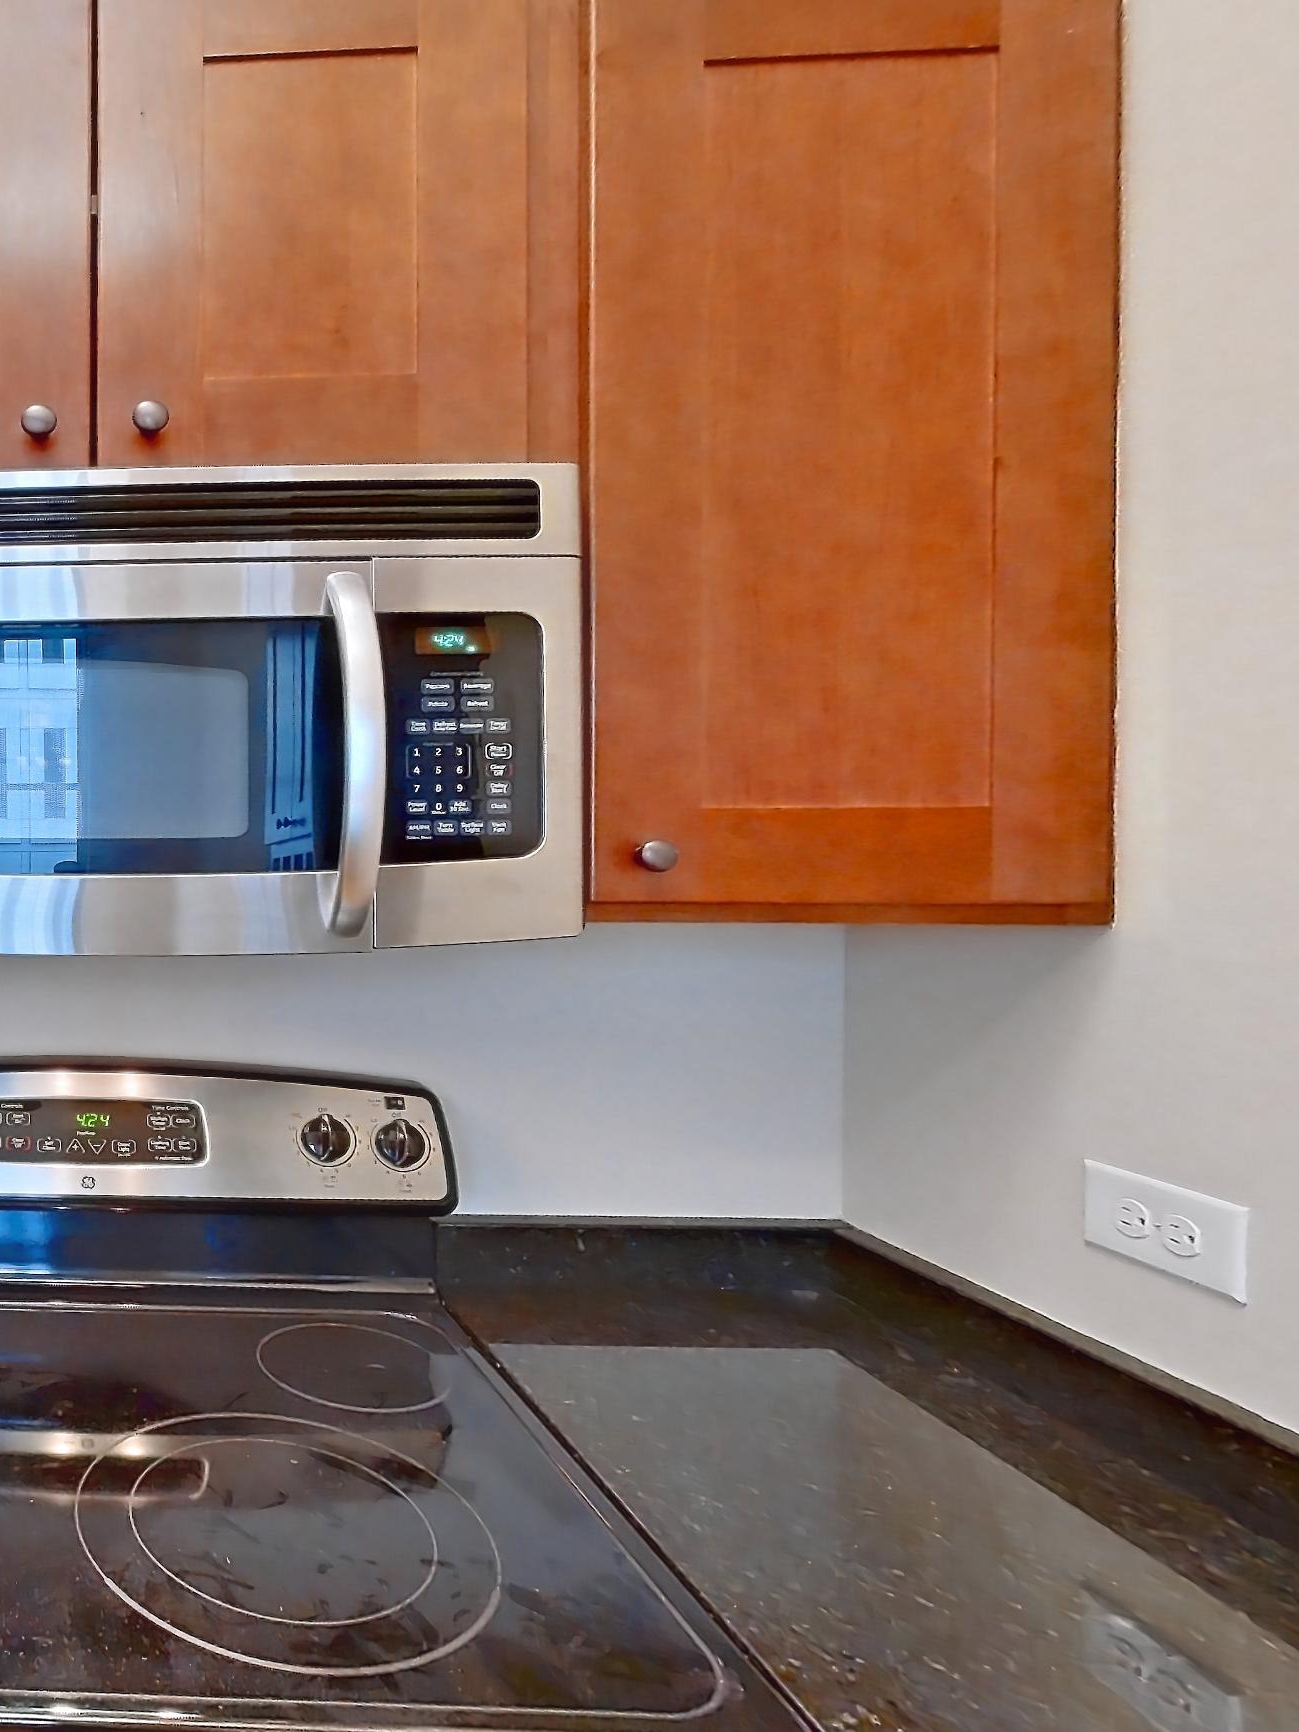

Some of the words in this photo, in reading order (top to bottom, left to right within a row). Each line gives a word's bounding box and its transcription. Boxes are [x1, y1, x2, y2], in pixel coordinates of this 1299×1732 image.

[435, 748, 442, 756] 2
[456, 748, 463, 756] 3
[414, 766, 420, 774] 4
[414, 784, 420, 792] 7
[436, 784, 442, 792] 8
[457, 784, 463, 792] 9
